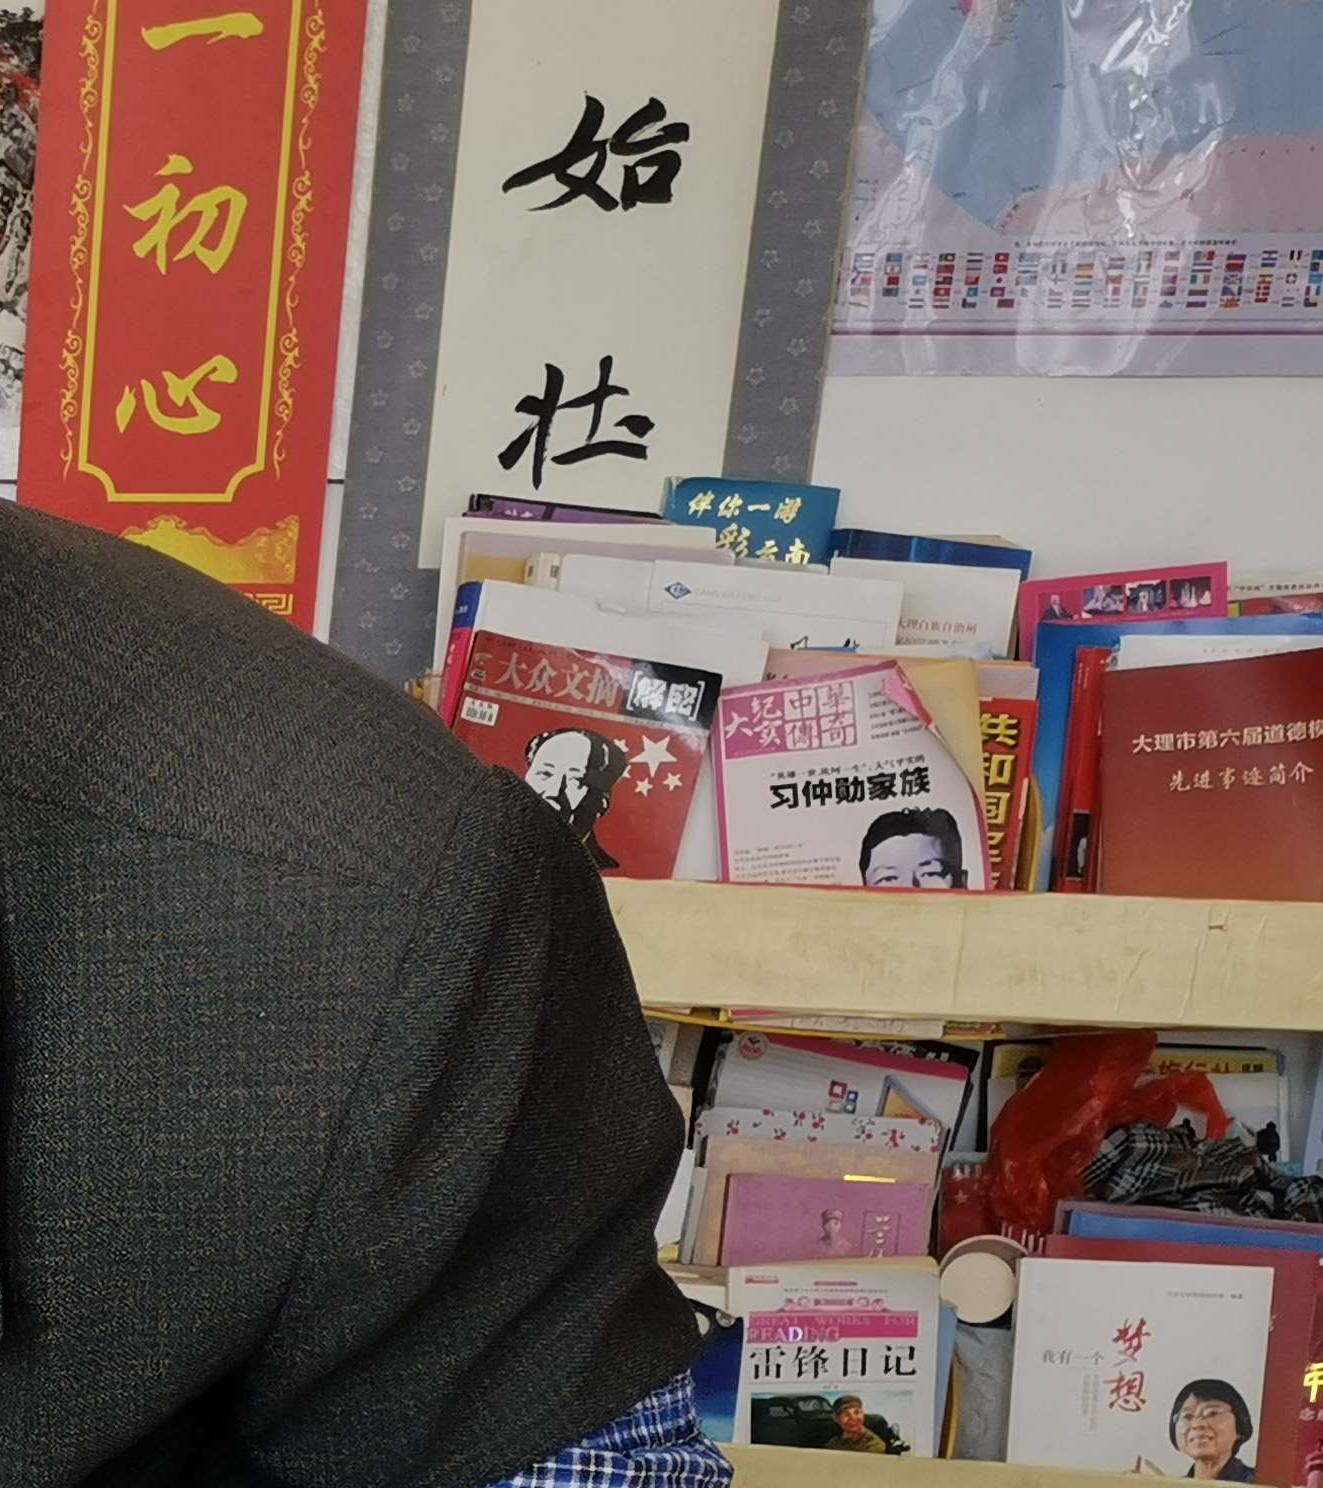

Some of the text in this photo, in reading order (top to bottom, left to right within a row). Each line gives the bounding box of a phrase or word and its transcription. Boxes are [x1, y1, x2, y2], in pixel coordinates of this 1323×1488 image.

[116, 10, 264, 435] 一初心
[501, 92, 690, 489] 始壮
[497, 651, 621, 706] 大众文摘
[769, 767, 931, 809] 习仲勋家族
[1168, 760, 1316, 793] 先进事迹简介
[749, 1344, 918, 1380] 雷锋日记
[1104, 1317, 1152, 1413] 梦想
